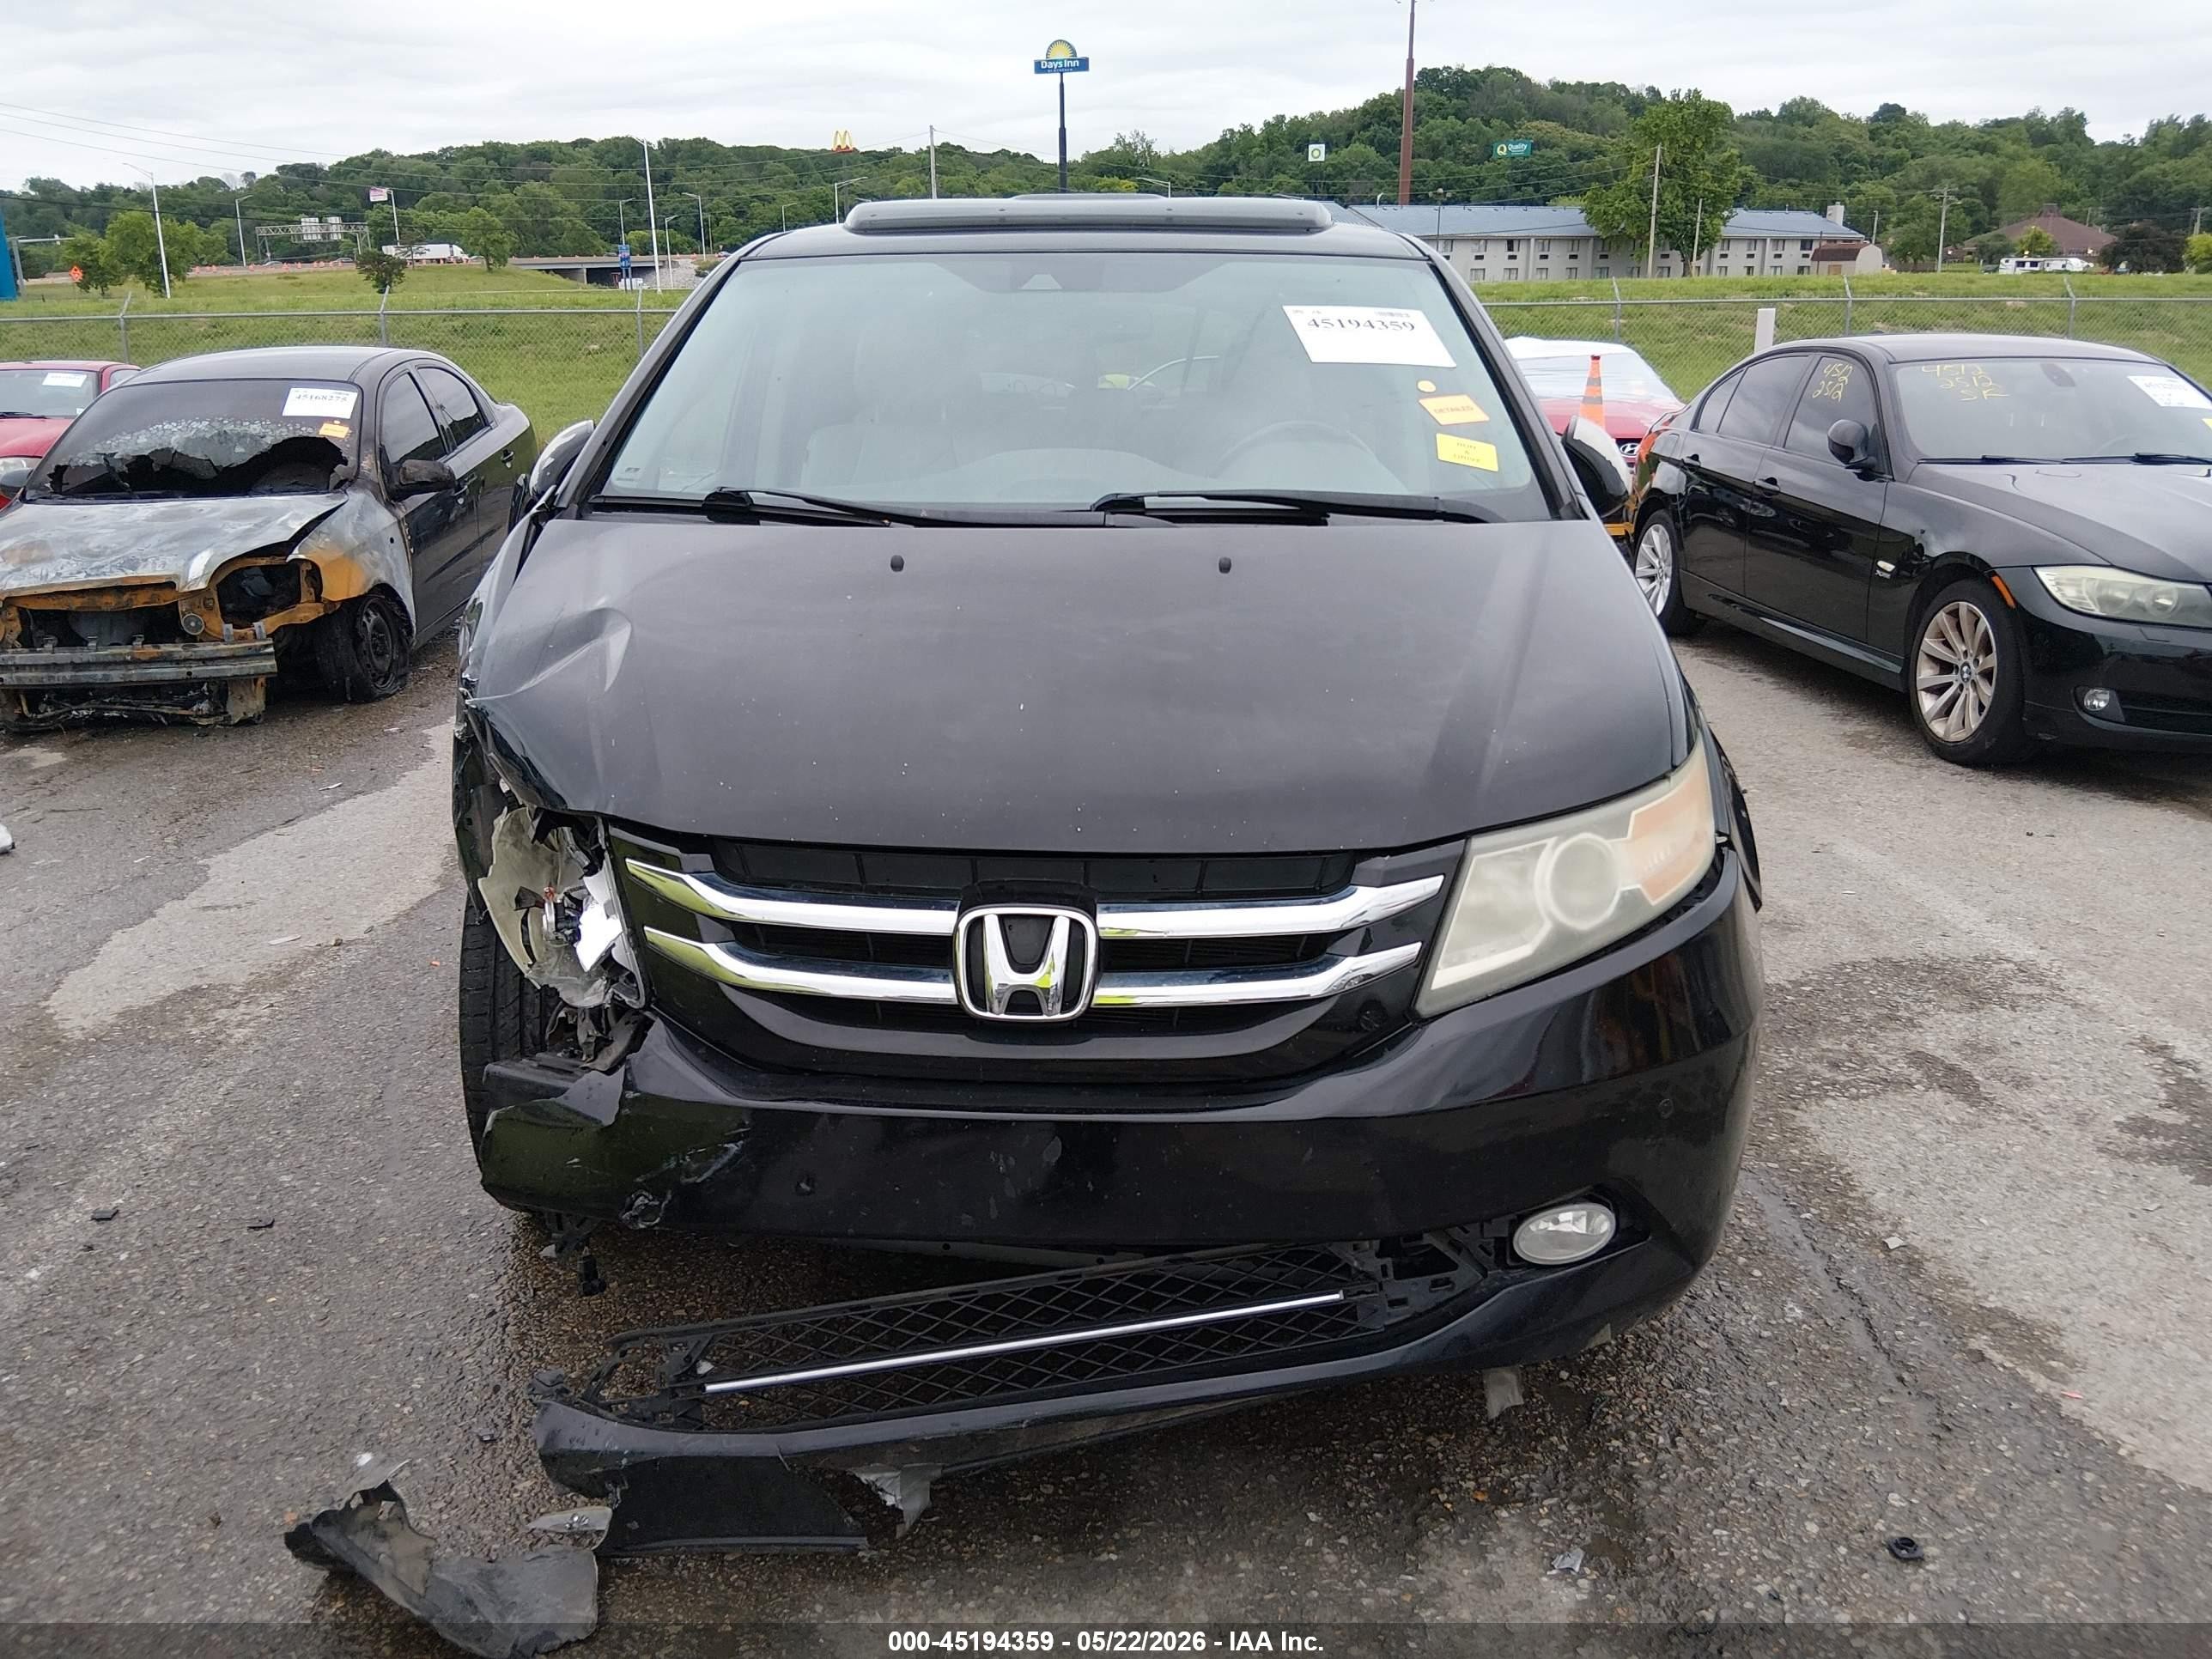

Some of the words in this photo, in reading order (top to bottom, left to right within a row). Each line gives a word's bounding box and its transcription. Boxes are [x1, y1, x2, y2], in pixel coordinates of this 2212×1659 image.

[1041, 60, 1064, 70] Days
[1064, 59, 1079, 68] Inn
[1307, 318, 1415, 331] 45194359
